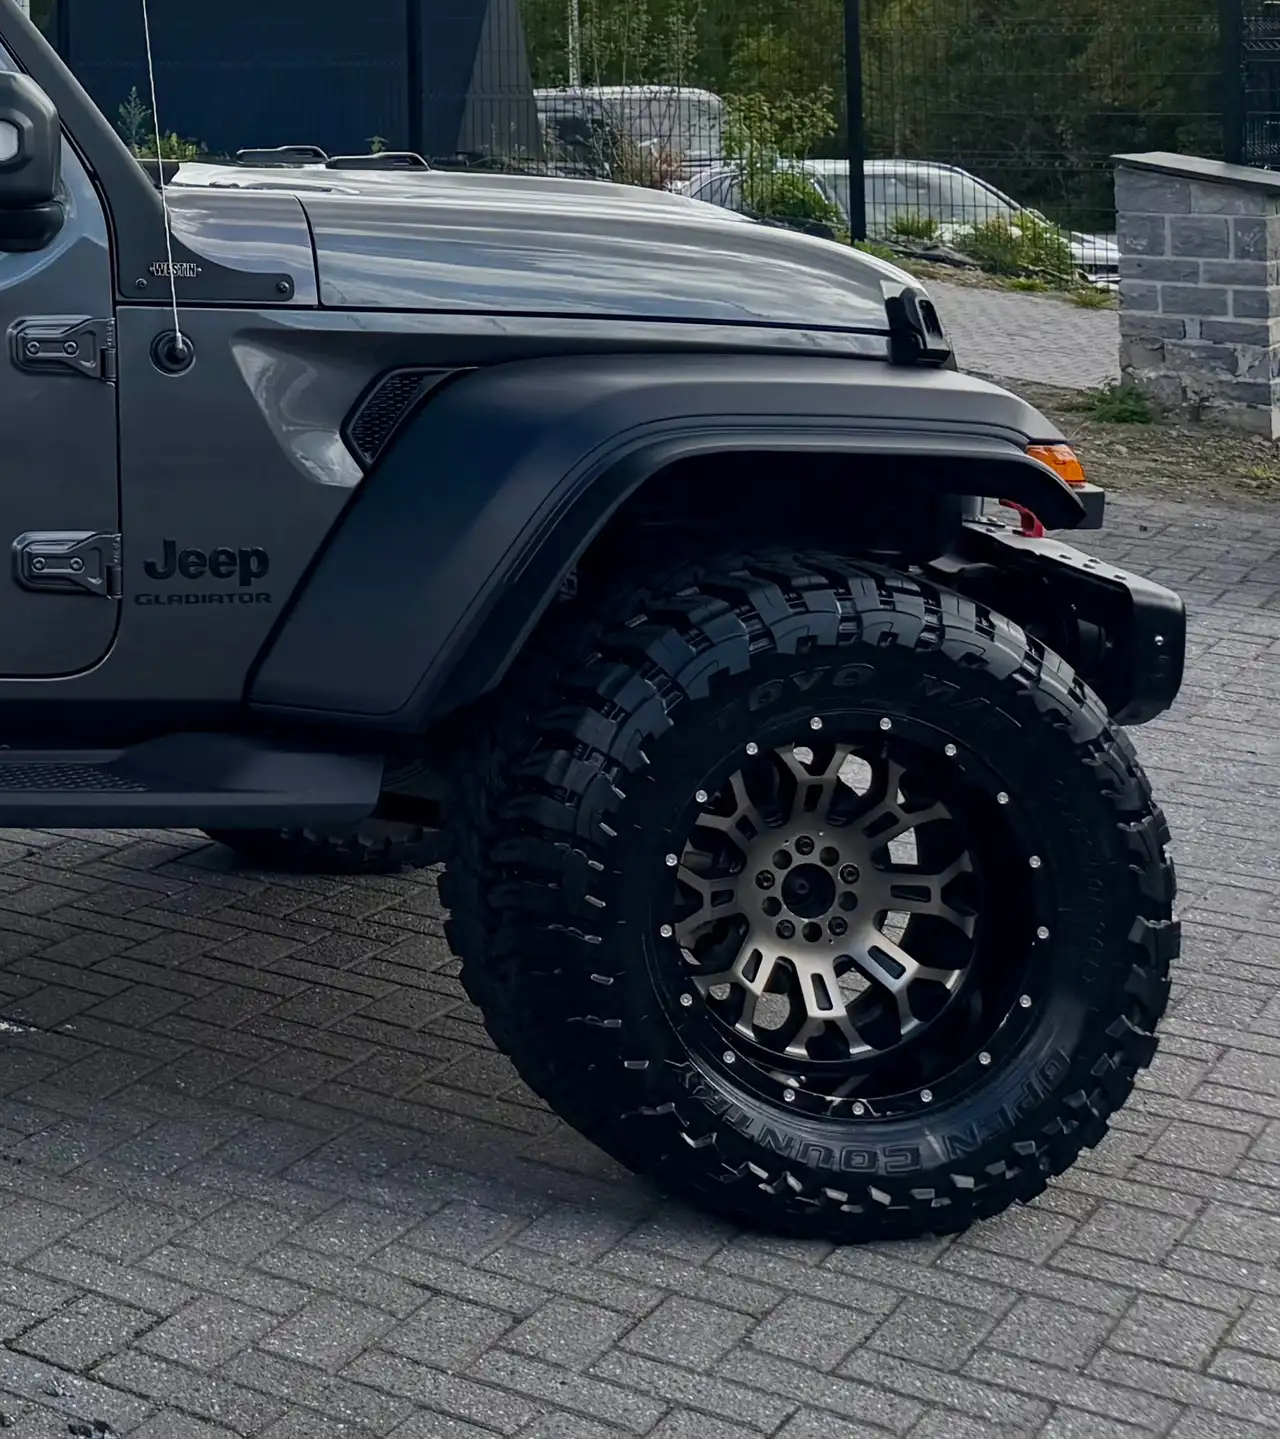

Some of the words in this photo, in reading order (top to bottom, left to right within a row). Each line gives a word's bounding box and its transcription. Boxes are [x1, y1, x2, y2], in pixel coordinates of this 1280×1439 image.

[152, 262, 197, 277] WESTIN
[143, 538, 270, 587] Jeep
[134, 592, 272, 606] GLADIATOR
